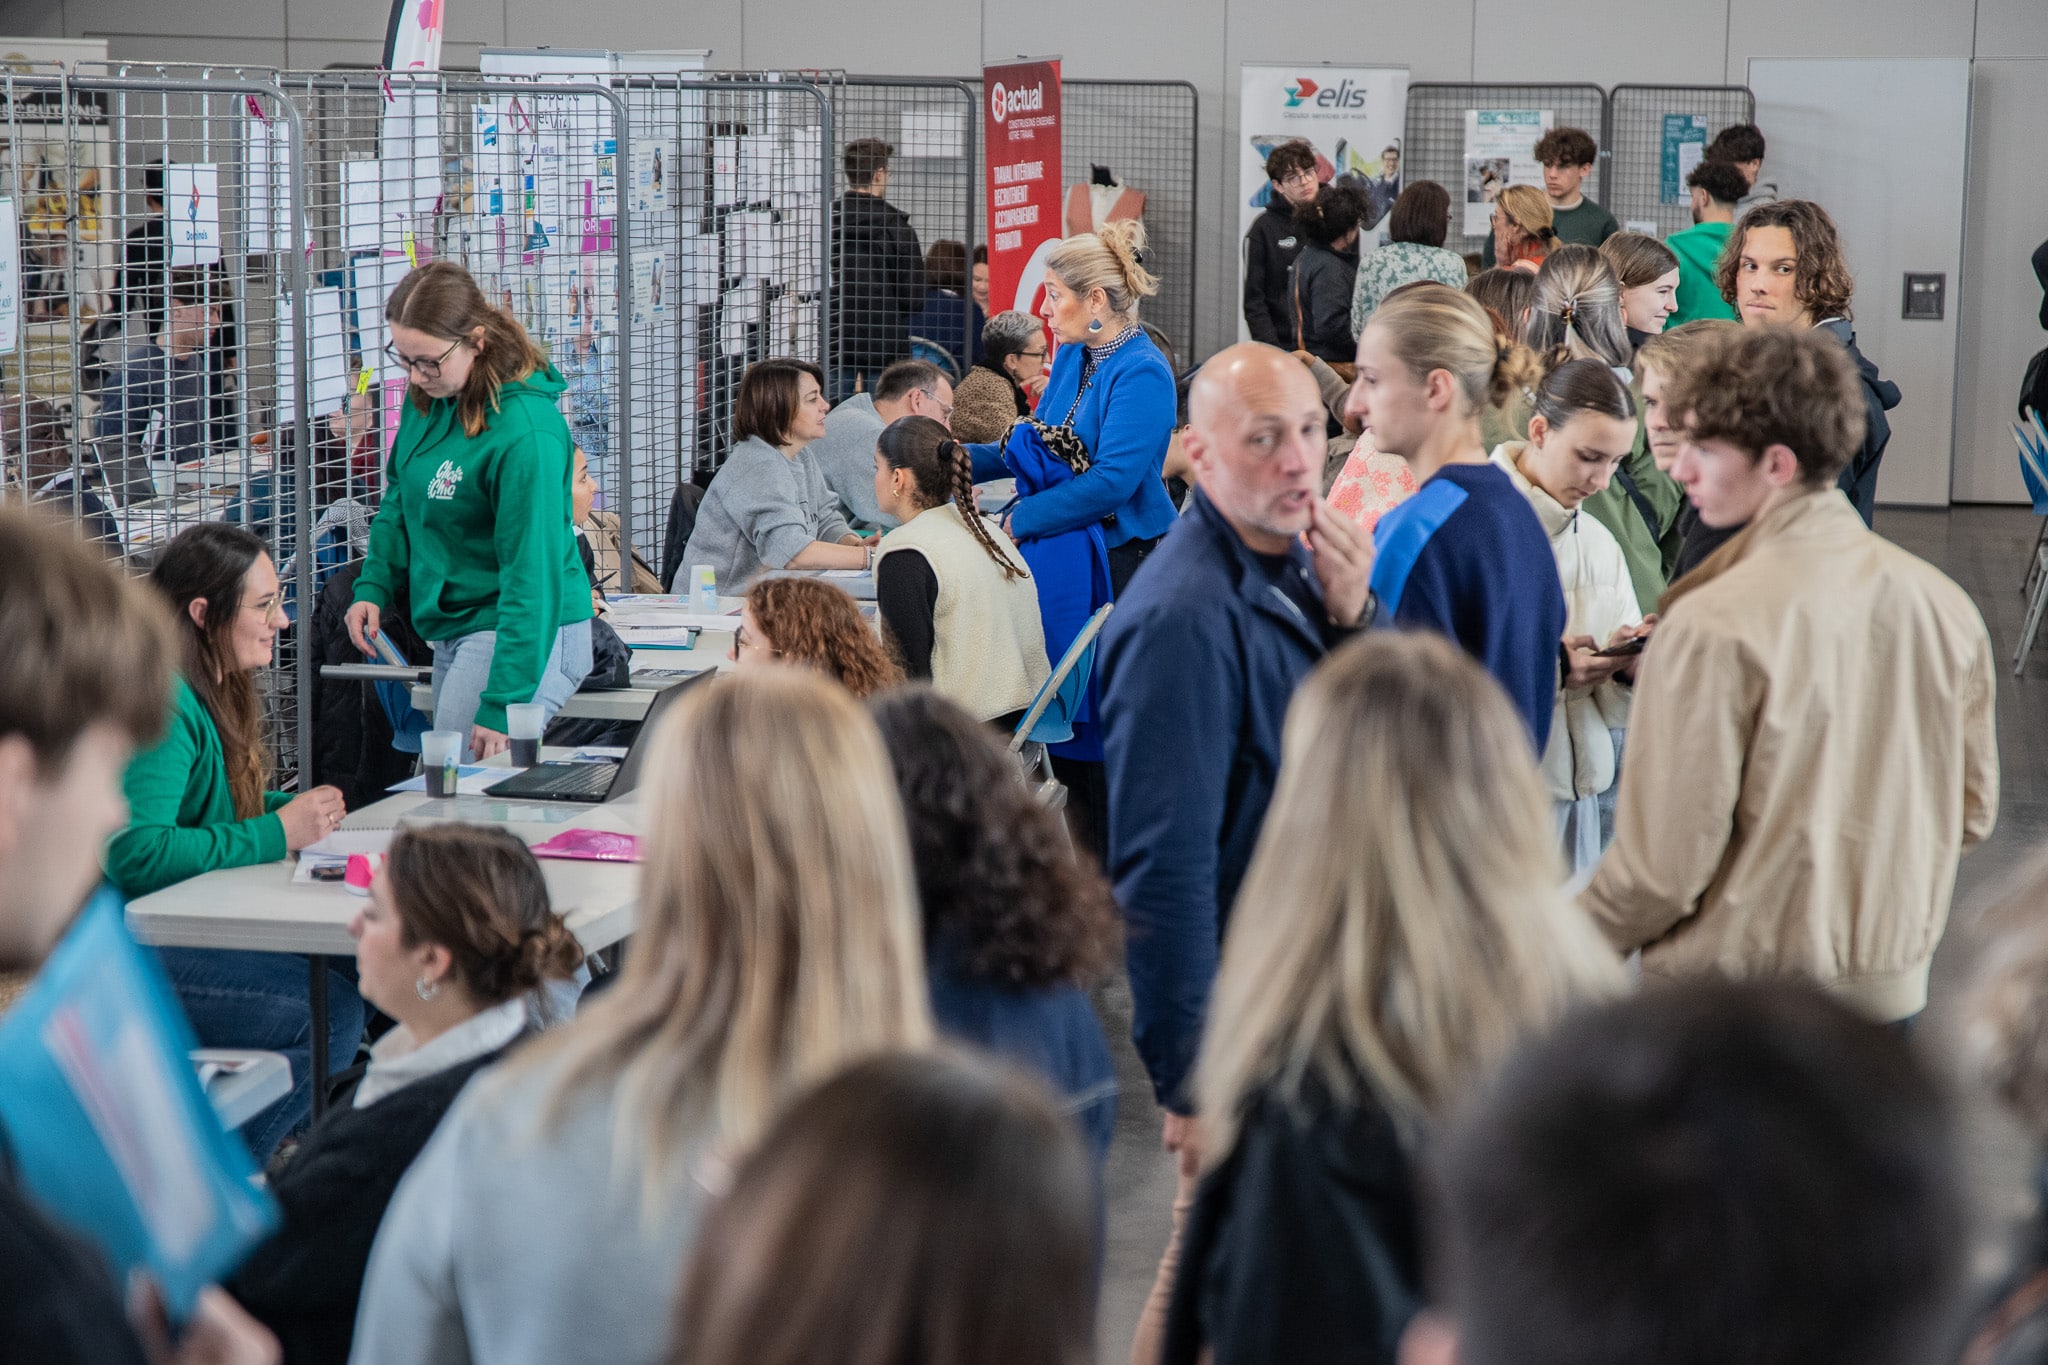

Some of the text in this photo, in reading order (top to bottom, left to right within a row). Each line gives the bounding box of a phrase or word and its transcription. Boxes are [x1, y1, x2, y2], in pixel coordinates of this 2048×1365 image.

[1007, 81, 1043, 112] actual
[1316, 78, 1367, 108] elis
[186, 228, 208, 241] Domino's
